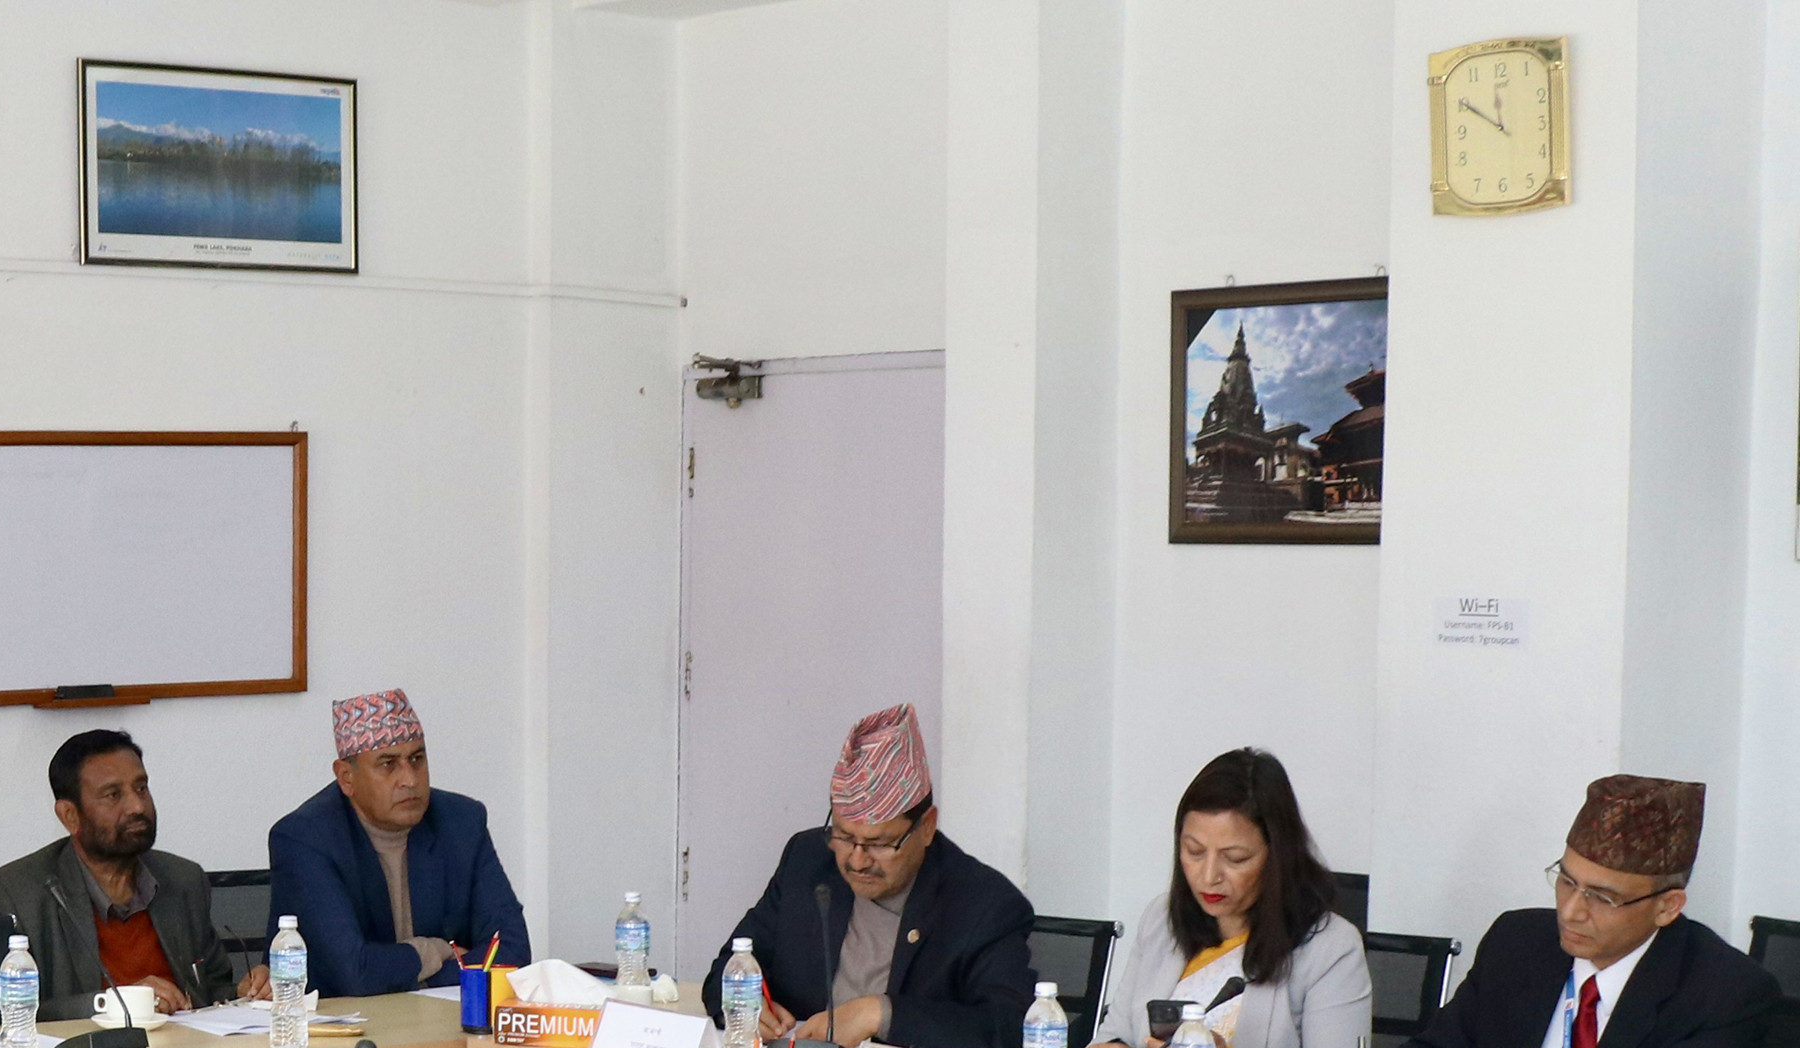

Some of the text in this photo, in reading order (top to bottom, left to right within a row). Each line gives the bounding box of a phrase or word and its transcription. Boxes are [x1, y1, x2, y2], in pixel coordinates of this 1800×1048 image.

[1469, 67, 1479, 83] 11
[1494, 62, 1507, 79] 12
[1536, 88, 1546, 104] 2
[1538, 115, 1546, 131] 3
[1457, 125, 1467, 140] 9
[1458, 151, 1468, 166] 8
[1538, 144, 1547, 159] 4
[1473, 178, 1482, 193] 7
[1498, 177, 1508, 193] 6
[1526, 172, 1535, 189] 5
[1459, 598, 1499, 614] Wi-Fi
[498, 1012, 595, 1037] PREMIUM
